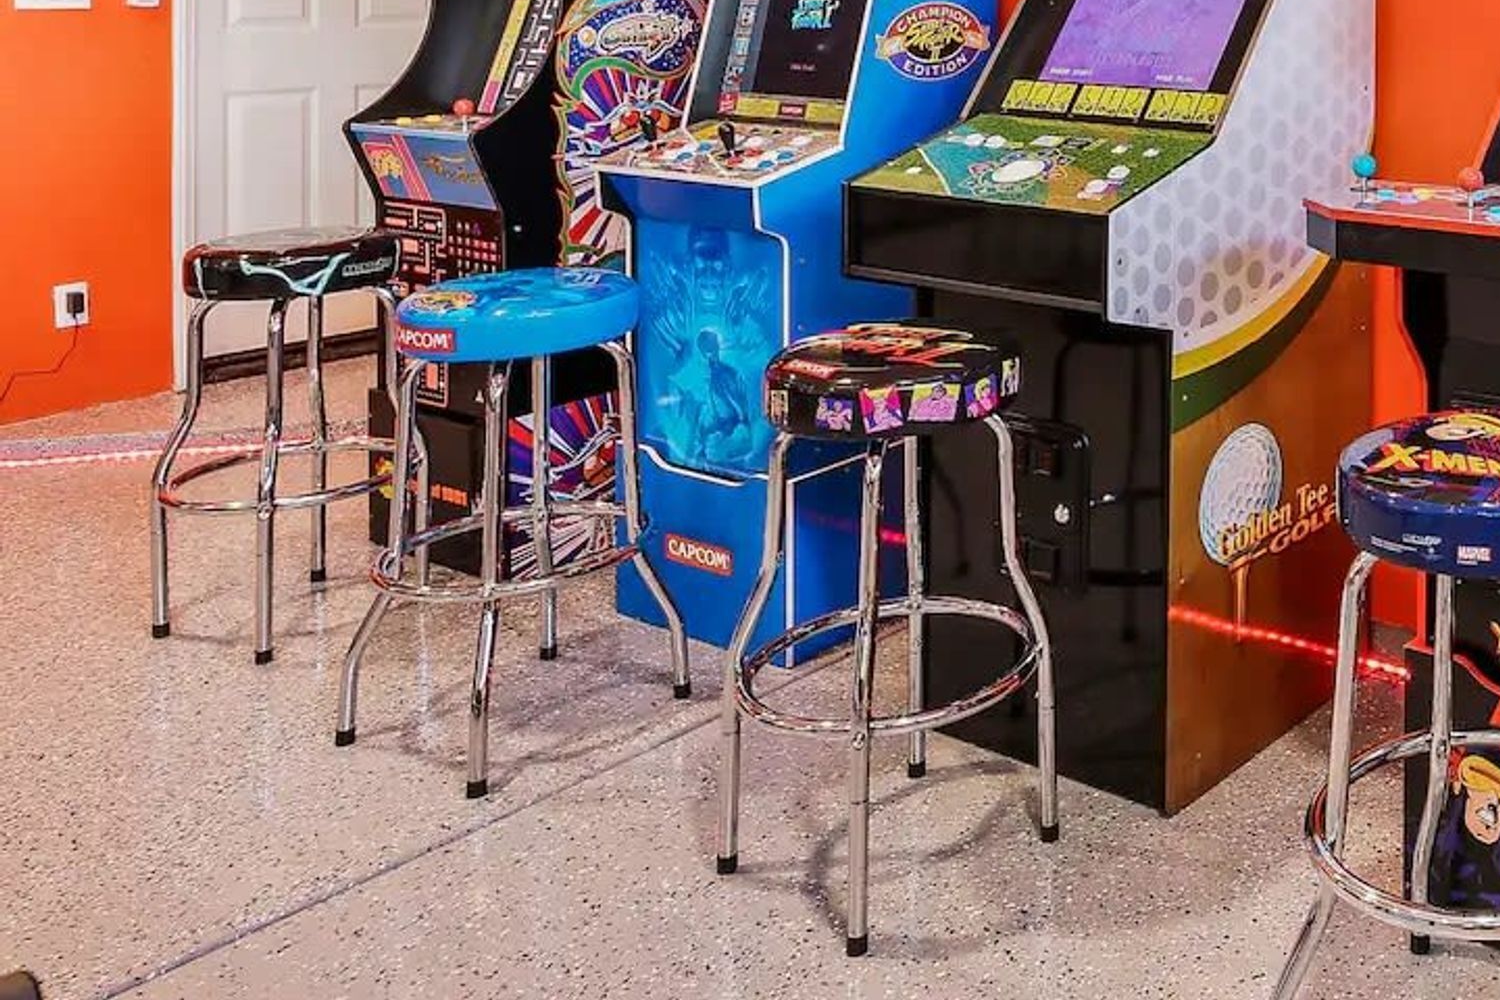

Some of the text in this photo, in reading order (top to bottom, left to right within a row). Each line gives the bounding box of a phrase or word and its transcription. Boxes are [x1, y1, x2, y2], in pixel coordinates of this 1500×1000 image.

[896, 6, 971, 34] CHAMPION
[901, 52, 968, 77] EDITION
[1217, 483, 1329, 560] Golden Tee
[668, 539, 731, 570] CAPCOM
